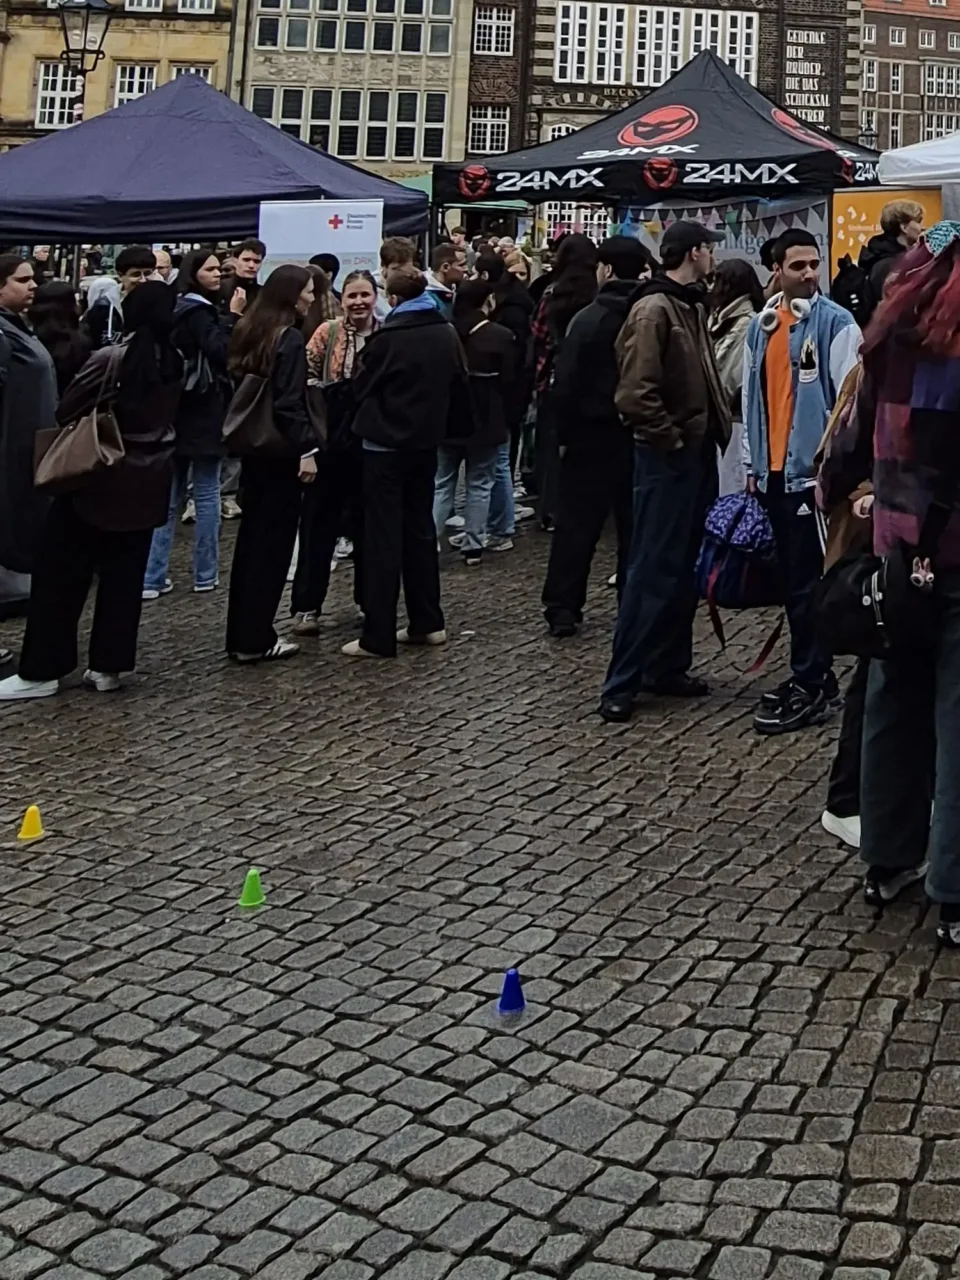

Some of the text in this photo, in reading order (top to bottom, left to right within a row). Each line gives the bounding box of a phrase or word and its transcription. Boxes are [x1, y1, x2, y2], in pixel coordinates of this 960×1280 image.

[787, 30, 826, 44] GEDENKE
[786, 46, 804, 58] DER
[785, 77, 819, 91] DIE DAS
[785, 93, 830, 107] SCHICKSAL
[683, 163, 800, 184] 24MX
[854, 162, 881, 181] 24M
[495, 168, 605, 192] 24MX
